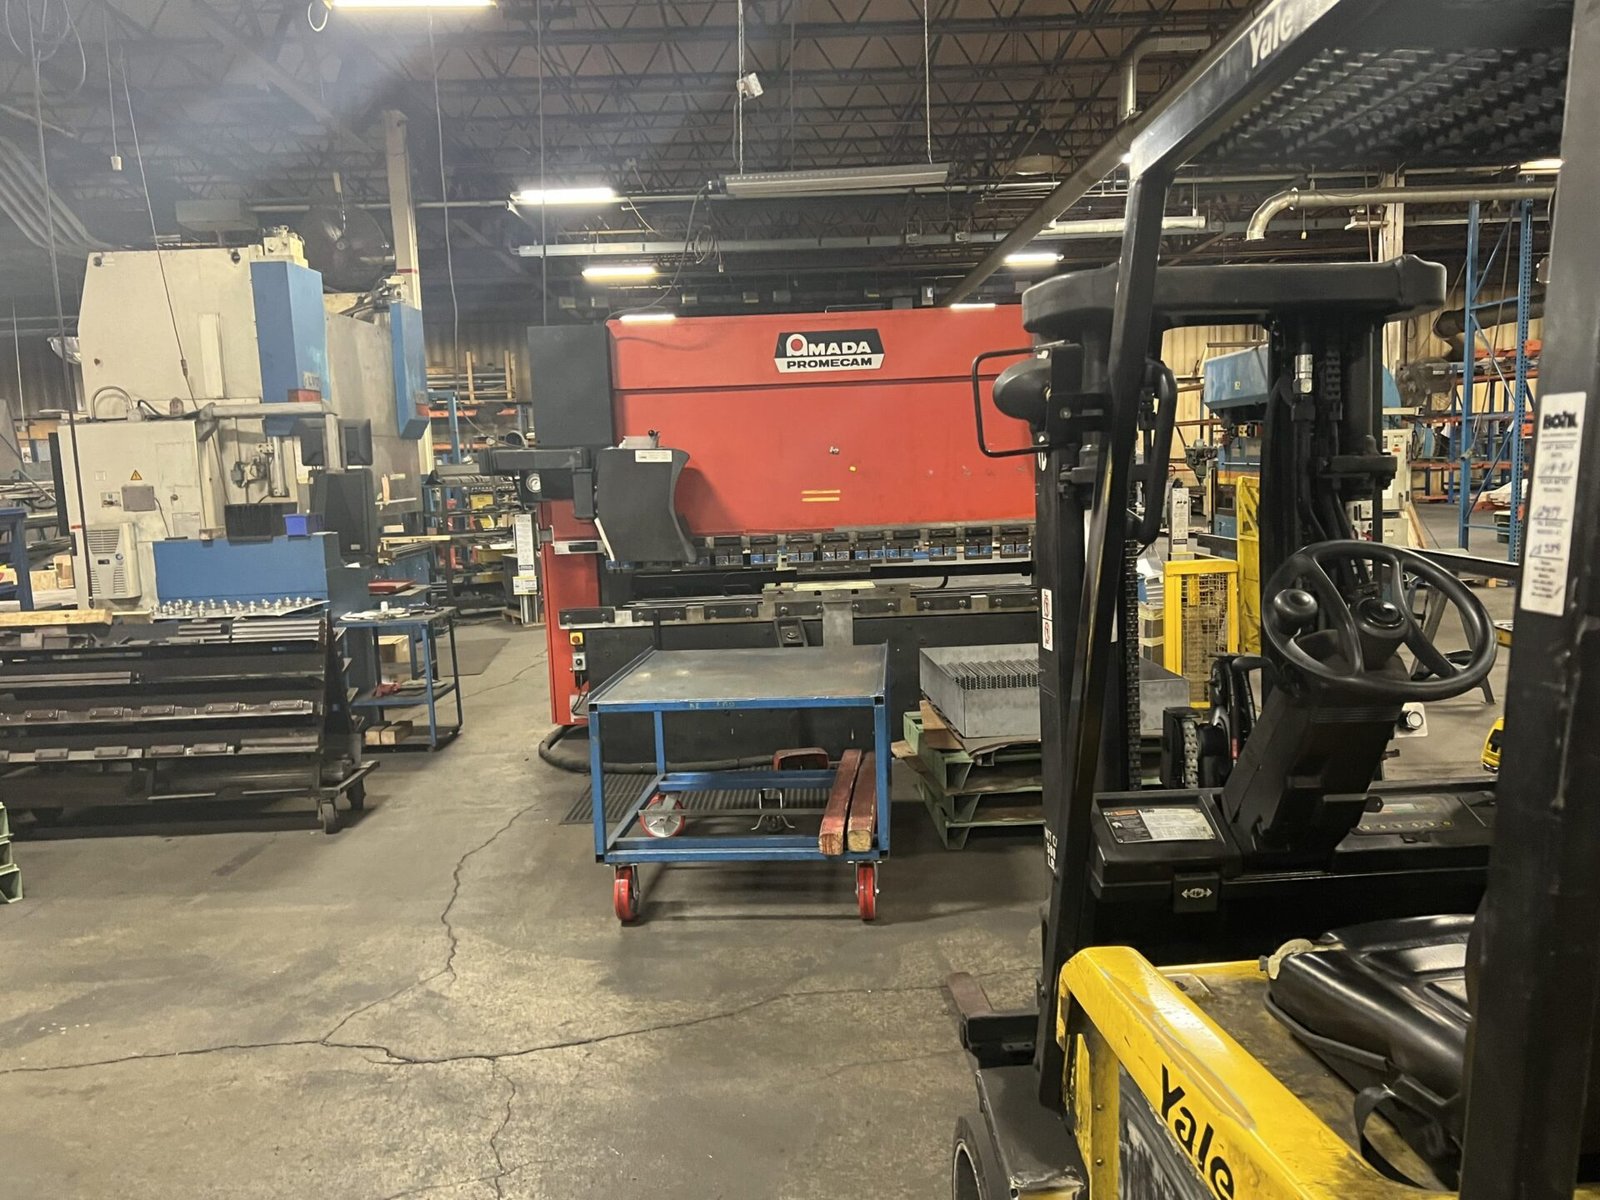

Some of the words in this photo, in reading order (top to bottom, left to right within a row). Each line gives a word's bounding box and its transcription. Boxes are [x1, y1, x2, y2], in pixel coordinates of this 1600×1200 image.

[1249, 5, 1294, 68] Yale
[786, 333, 871, 356] AMADA
[787, 358, 872, 369] PROMECAM
[1160, 1063, 1234, 1200] Yale
